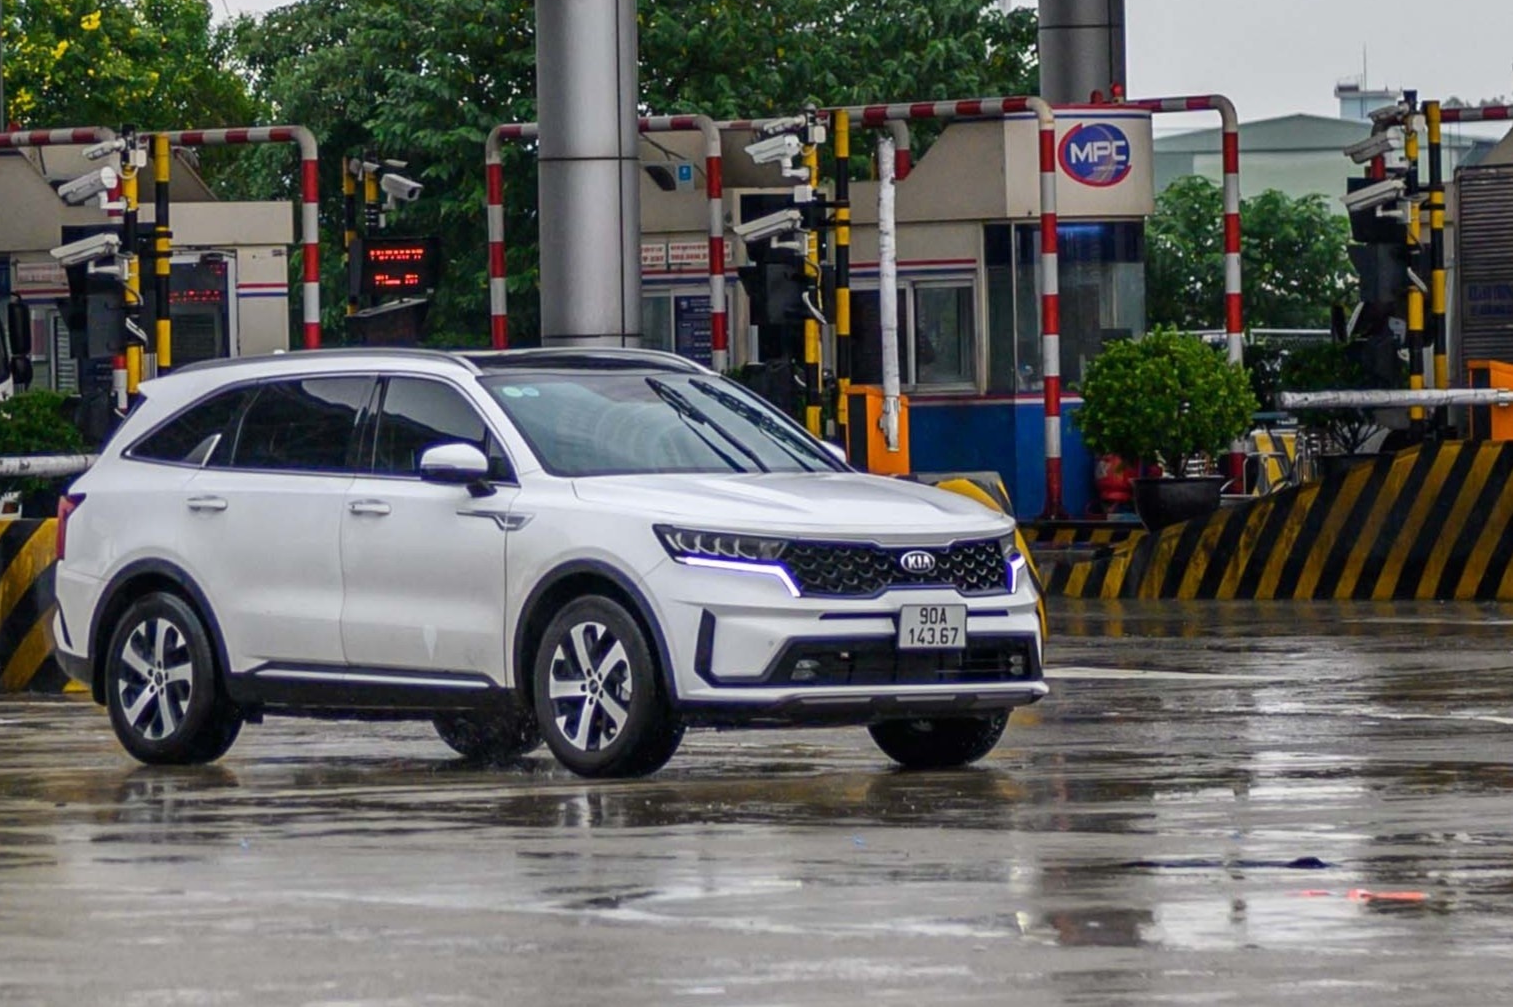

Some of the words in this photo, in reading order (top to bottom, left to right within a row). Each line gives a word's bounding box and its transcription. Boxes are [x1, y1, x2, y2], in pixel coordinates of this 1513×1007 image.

[1070, 140, 1127, 164] MPC
[907, 555, 931, 569] KIA
[919, 607, 947, 625] 90A
[908, 627, 959, 645] 143.67
